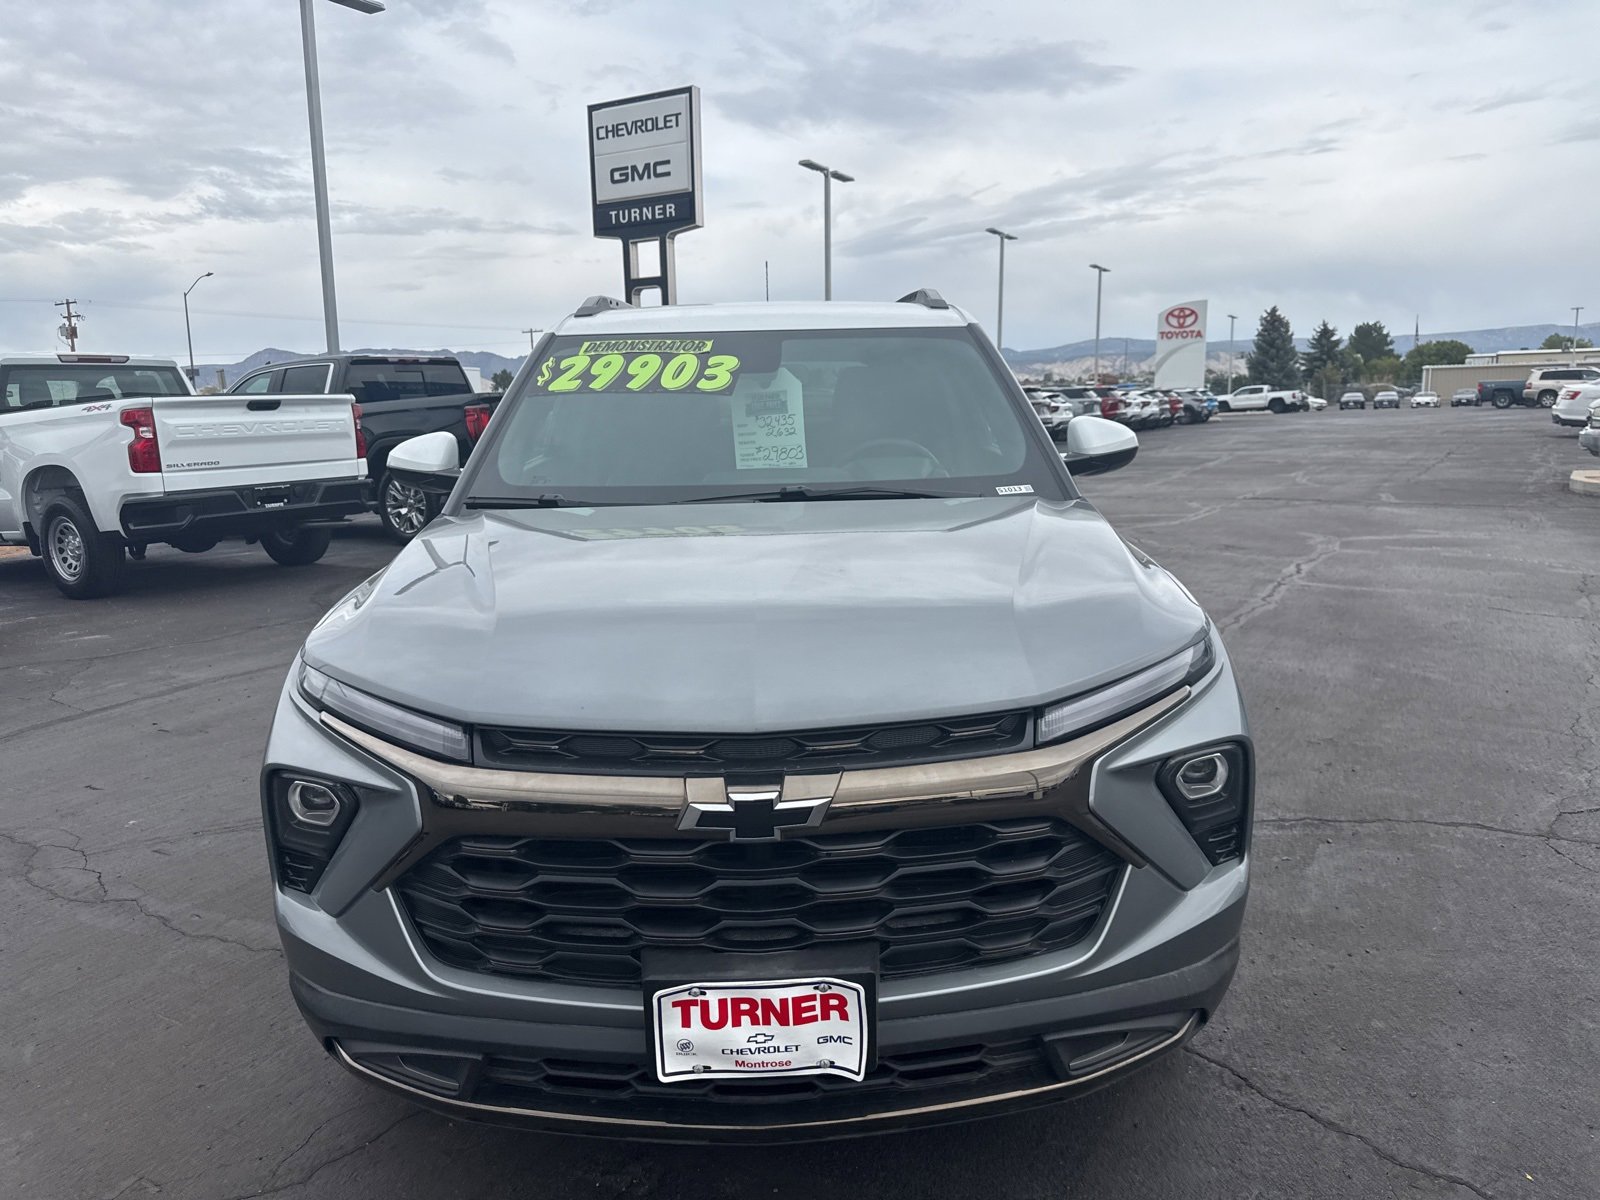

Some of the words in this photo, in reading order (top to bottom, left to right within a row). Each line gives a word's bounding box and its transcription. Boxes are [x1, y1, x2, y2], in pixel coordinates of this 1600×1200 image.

[596, 112, 682, 141] CHEVROLET
[609, 159, 672, 185] GMC
[609, 203, 677, 225] TURNER
[1158, 330, 1203, 340] TOYOTA
[582, 339, 708, 354] DEMONSTRATOR
[537, 354, 741, 392] $29903
[175, 420, 345, 438] CHEVROLET
[165, 460, 220, 469] SILVERADO
[671, 992, 850, 1031] TURNER
[817, 1035, 853, 1046] GMC
[721, 1044, 802, 1056] CHEVROLET
[734, 1058, 792, 1069] Montrose
